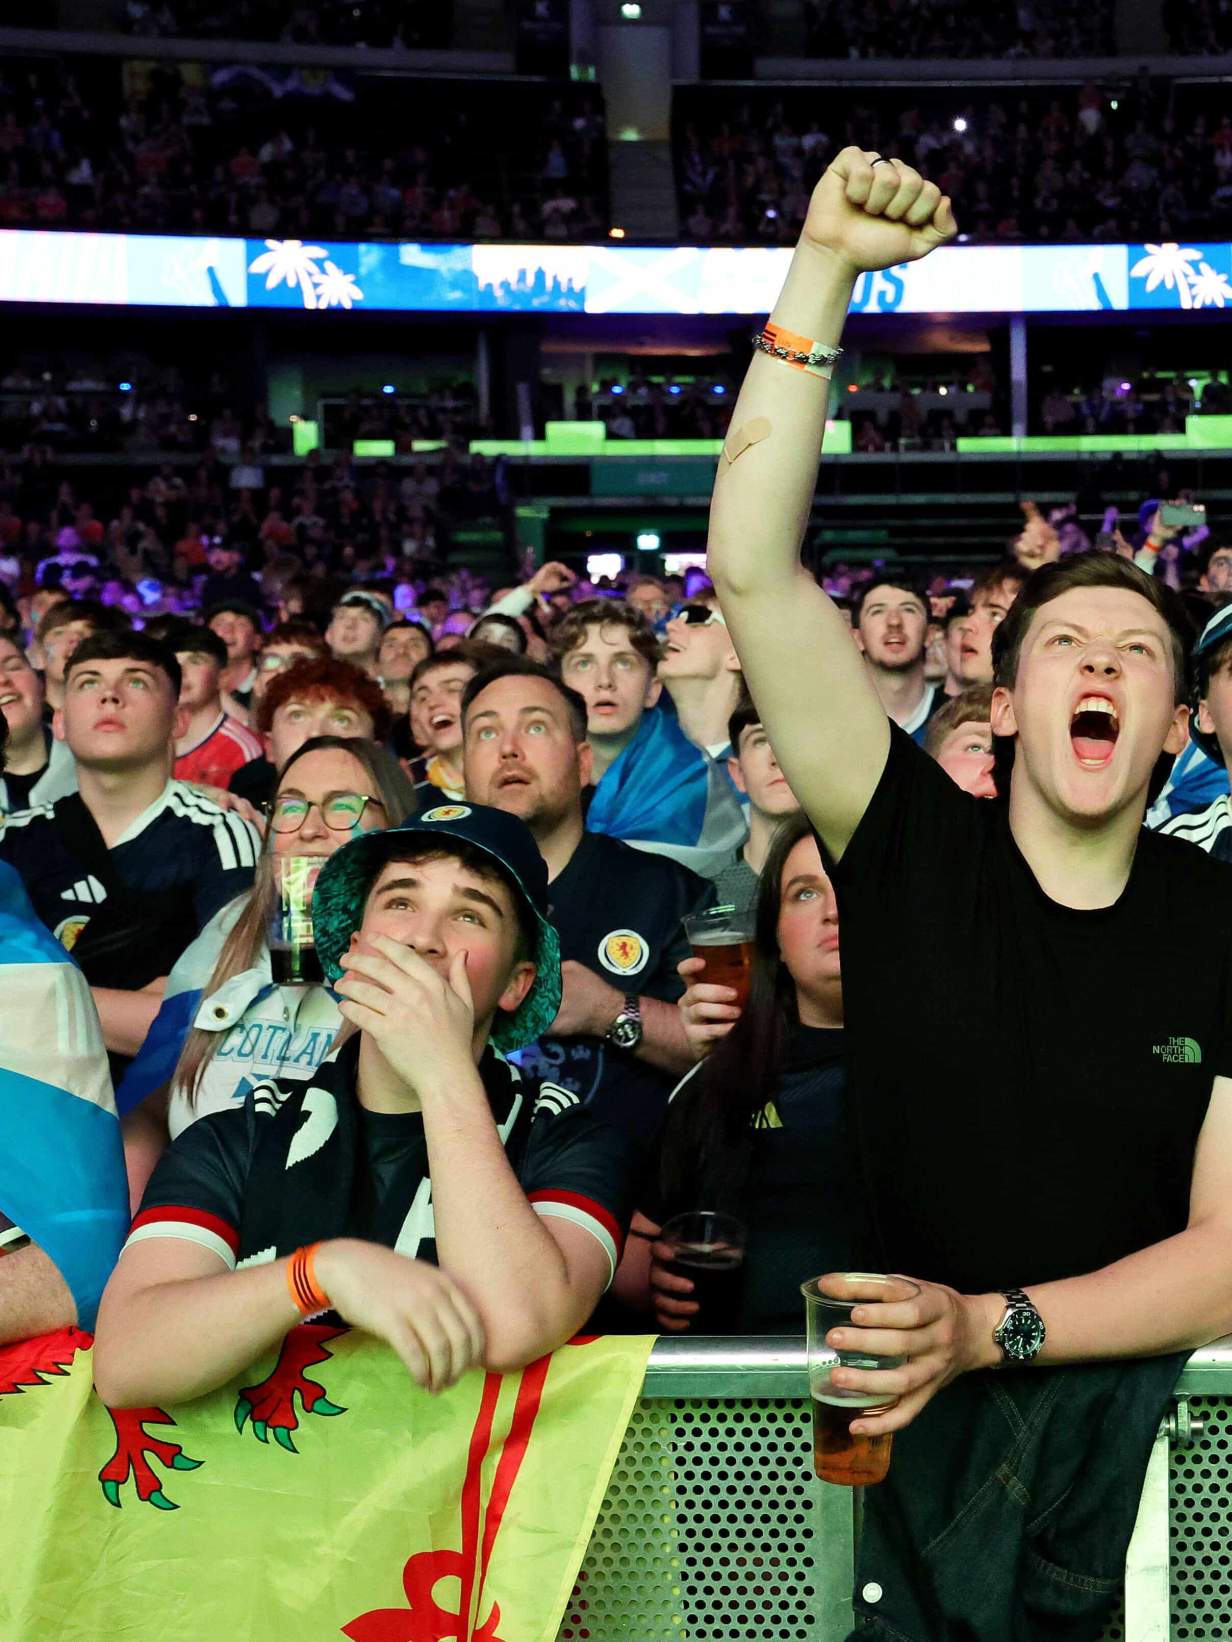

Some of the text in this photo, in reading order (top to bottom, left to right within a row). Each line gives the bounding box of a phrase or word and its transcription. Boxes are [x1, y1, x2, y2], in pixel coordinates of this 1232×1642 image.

[1168, 1036, 1185, 1046] THE
[1152, 1045, 1185, 1054] NORTH
[1162, 1054, 1185, 1063] FACE
